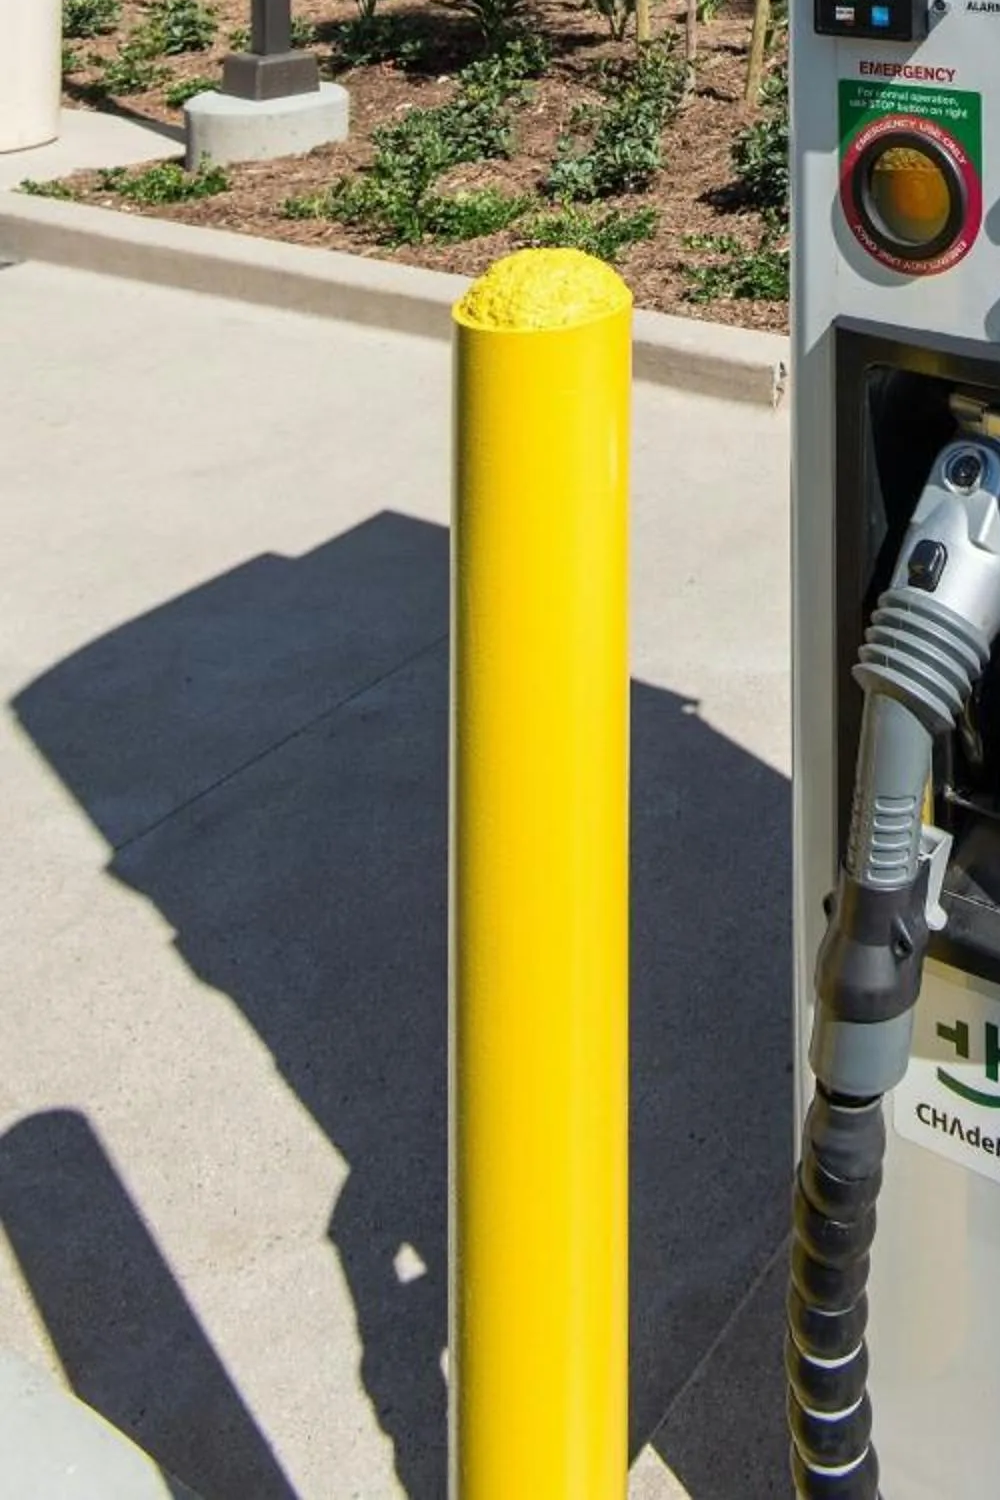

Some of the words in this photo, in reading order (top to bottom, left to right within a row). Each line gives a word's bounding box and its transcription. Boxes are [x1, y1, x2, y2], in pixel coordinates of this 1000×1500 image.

[859, 60, 956, 83] EMERGENCY
[857, 86, 874, 97] For
[869, 99, 895, 111] STOP
[897, 101, 929, 115] button
[930, 106, 943, 116] on
[944, 106, 969, 121] right
[855, 118, 917, 152] EMERGENCY
[942, 136, 967, 165] ONLY
